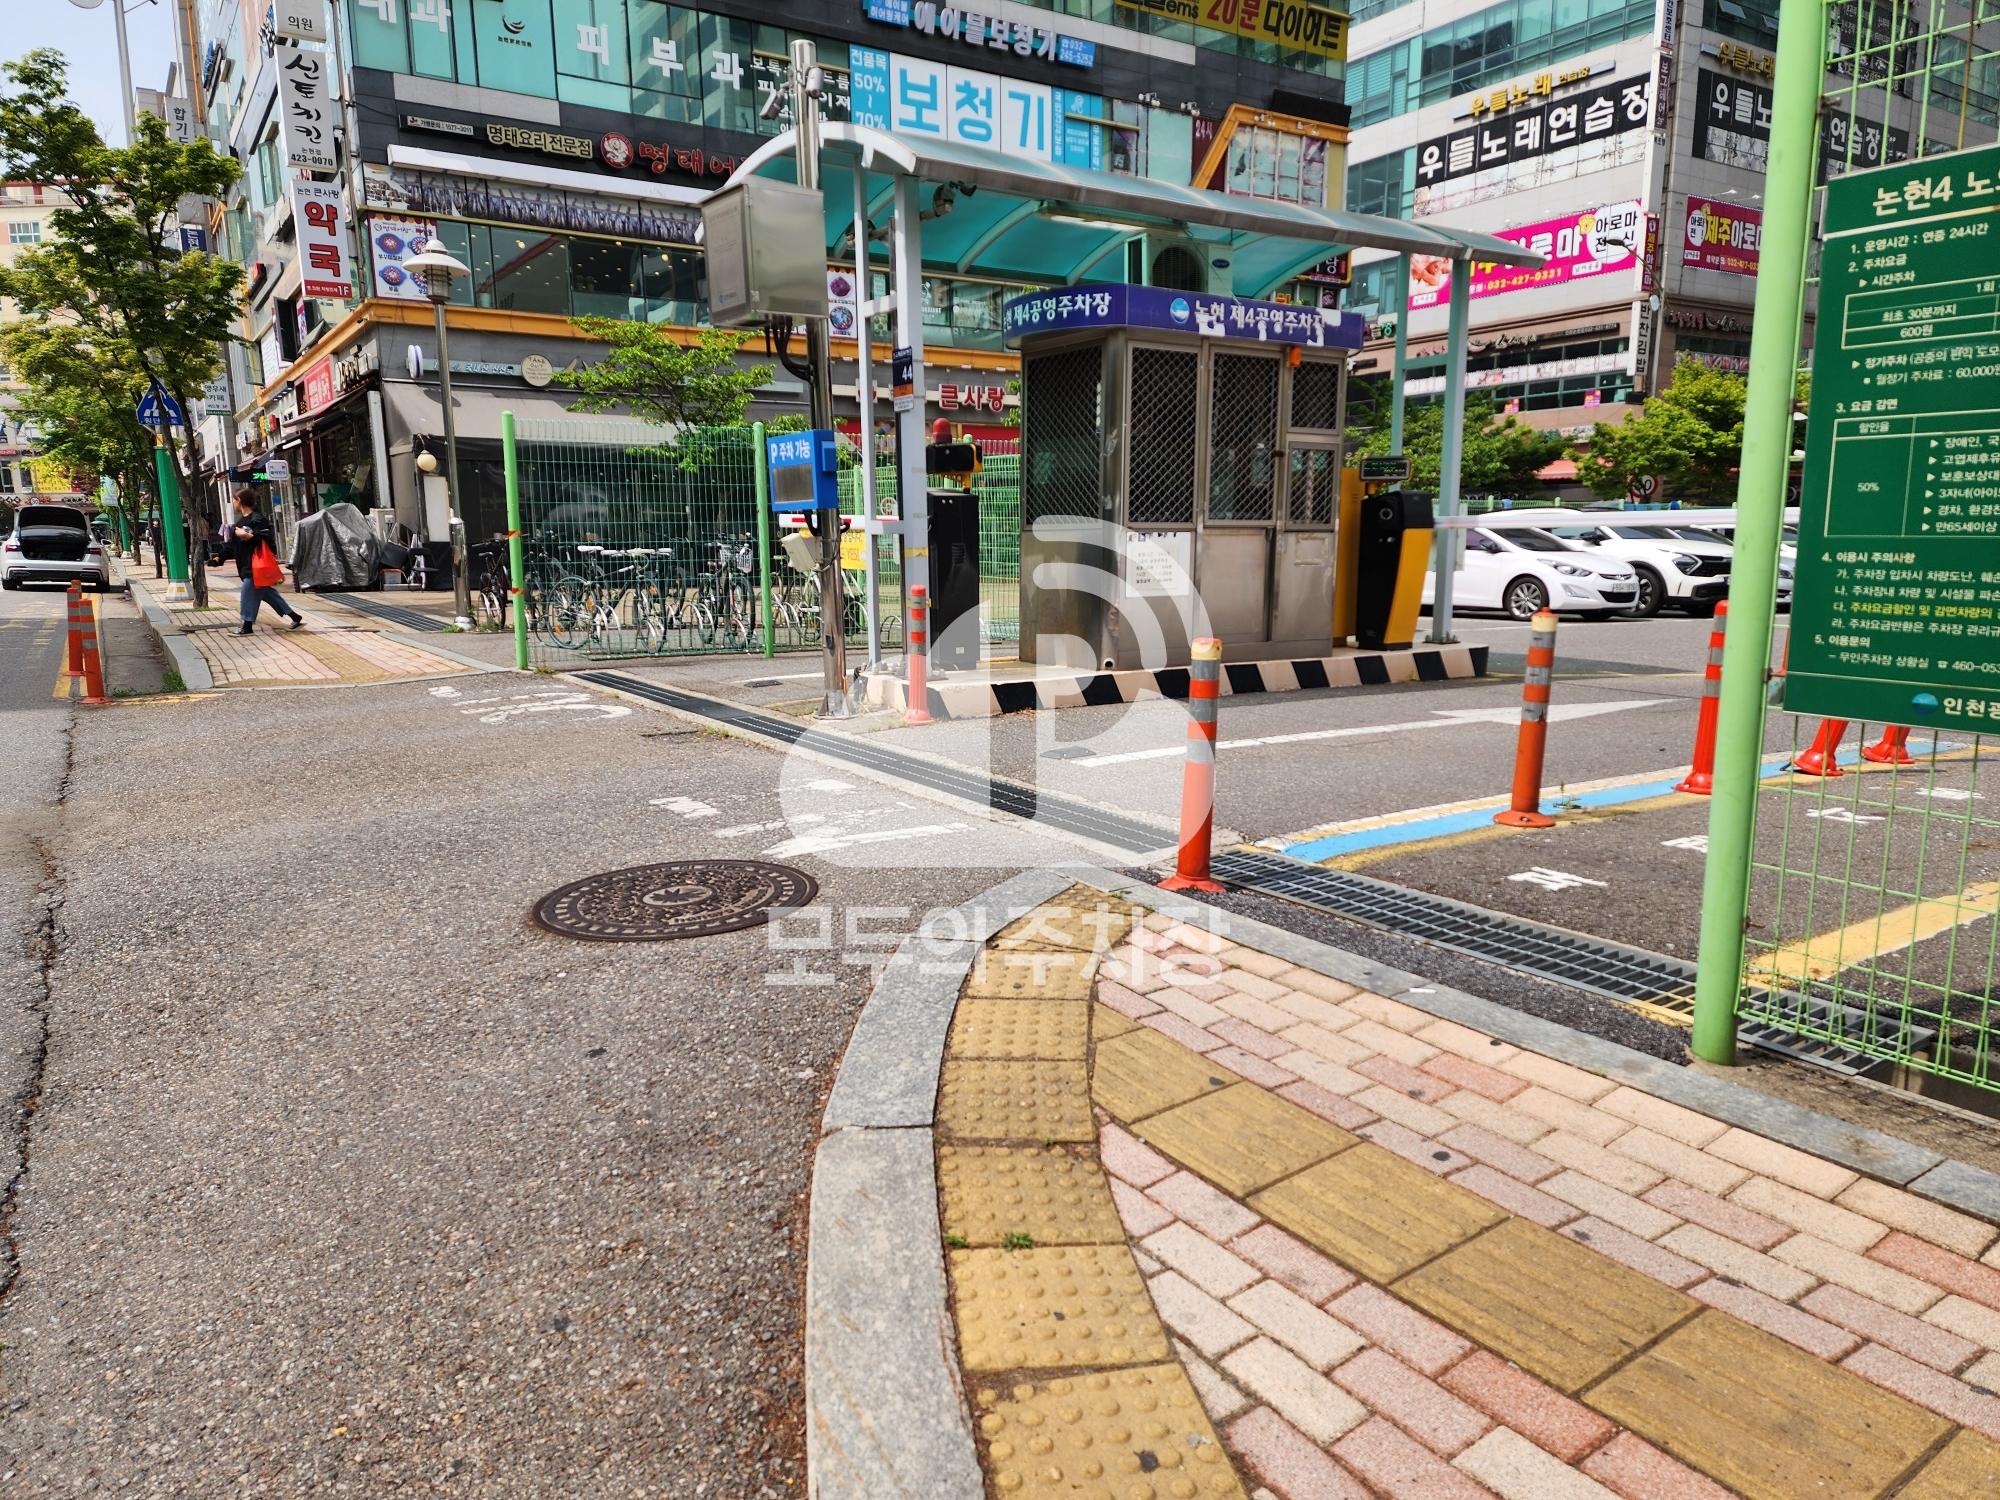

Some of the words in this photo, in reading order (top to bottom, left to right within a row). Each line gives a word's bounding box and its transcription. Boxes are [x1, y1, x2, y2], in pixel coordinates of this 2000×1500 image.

[288, 15, 313, 32] 의원
[913, 1, 1056, 62] 에이블보청기
[1264, 1, 1342, 49] 다이어트
[851, 48, 887, 71] 전품목
[854, 72, 886, 93] 50%
[1471, 72, 1553, 117] 우들노래
[899, 67, 1046, 153] 보청기
[855, 111, 887, 129] 70%
[291, 153, 333, 167] 423-0070
[639, 141, 750, 176] 명태어
[313, 187, 340, 200] 큰사랑
[1872, 175, 1953, 217] 논현4
[1961, 168, 2000, 198] 노
[1595, 210, 1638, 233] 아로마
[304, 201, 341, 278] 약국
[1851, 244, 1860, 254] 1.
[1864, 235, 1909, 252] 운영시간
[1922, 229, 1945, 243] 연중
[1949, 222, 1989, 239] 24시간
[1848, 262, 1859, 272] 2.
[1863, 253, 1907, 270] 주차요금
[1487, 268, 1562, 291] 032-427-0331
[1872, 270, 1915, 286] 시간주차
[338, 285, 350, 296] 1F
[1013, 292, 1112, 332] 제4공영주차장
[1882, 311, 1904, 323] 최초
[1907, 304, 1957, 320] 30분까지
[1900, 324, 1934, 338] 600원
[938, 384, 1005, 413] 큰사랑
[1836, 402, 1846, 413] 3.
[1851, 400, 1872, 412] 요금
[779, 442, 794, 460] 주차
[795, 440, 811, 458] 가능
[1857, 482, 1880, 492] 50%
[1822, 552, 1832, 562] 4.
[1836, 552, 1868, 563] 이용시
[1871, 552, 1916, 564] 주의사항
[1836, 568, 1850, 578] 가.
[1853, 568, 1886, 580] 주차장
[1834, 585, 1848, 596] 나.
[1852, 585, 1895, 598] 주차장내
[1899, 587, 1921, 598] 차량
[1940, 589, 1975, 600] 시설물
[1833, 602, 1846, 612] 다.
[1831, 618, 1845, 629] 라.
[1928, 622, 1963, 635] 주차장
[1815, 635, 1825, 645] 5.
[1828, 634, 1871, 647] 이용문의
[1839, 652, 1892, 666] 무인주차장
[1896, 656, 1929, 669] 상황실
